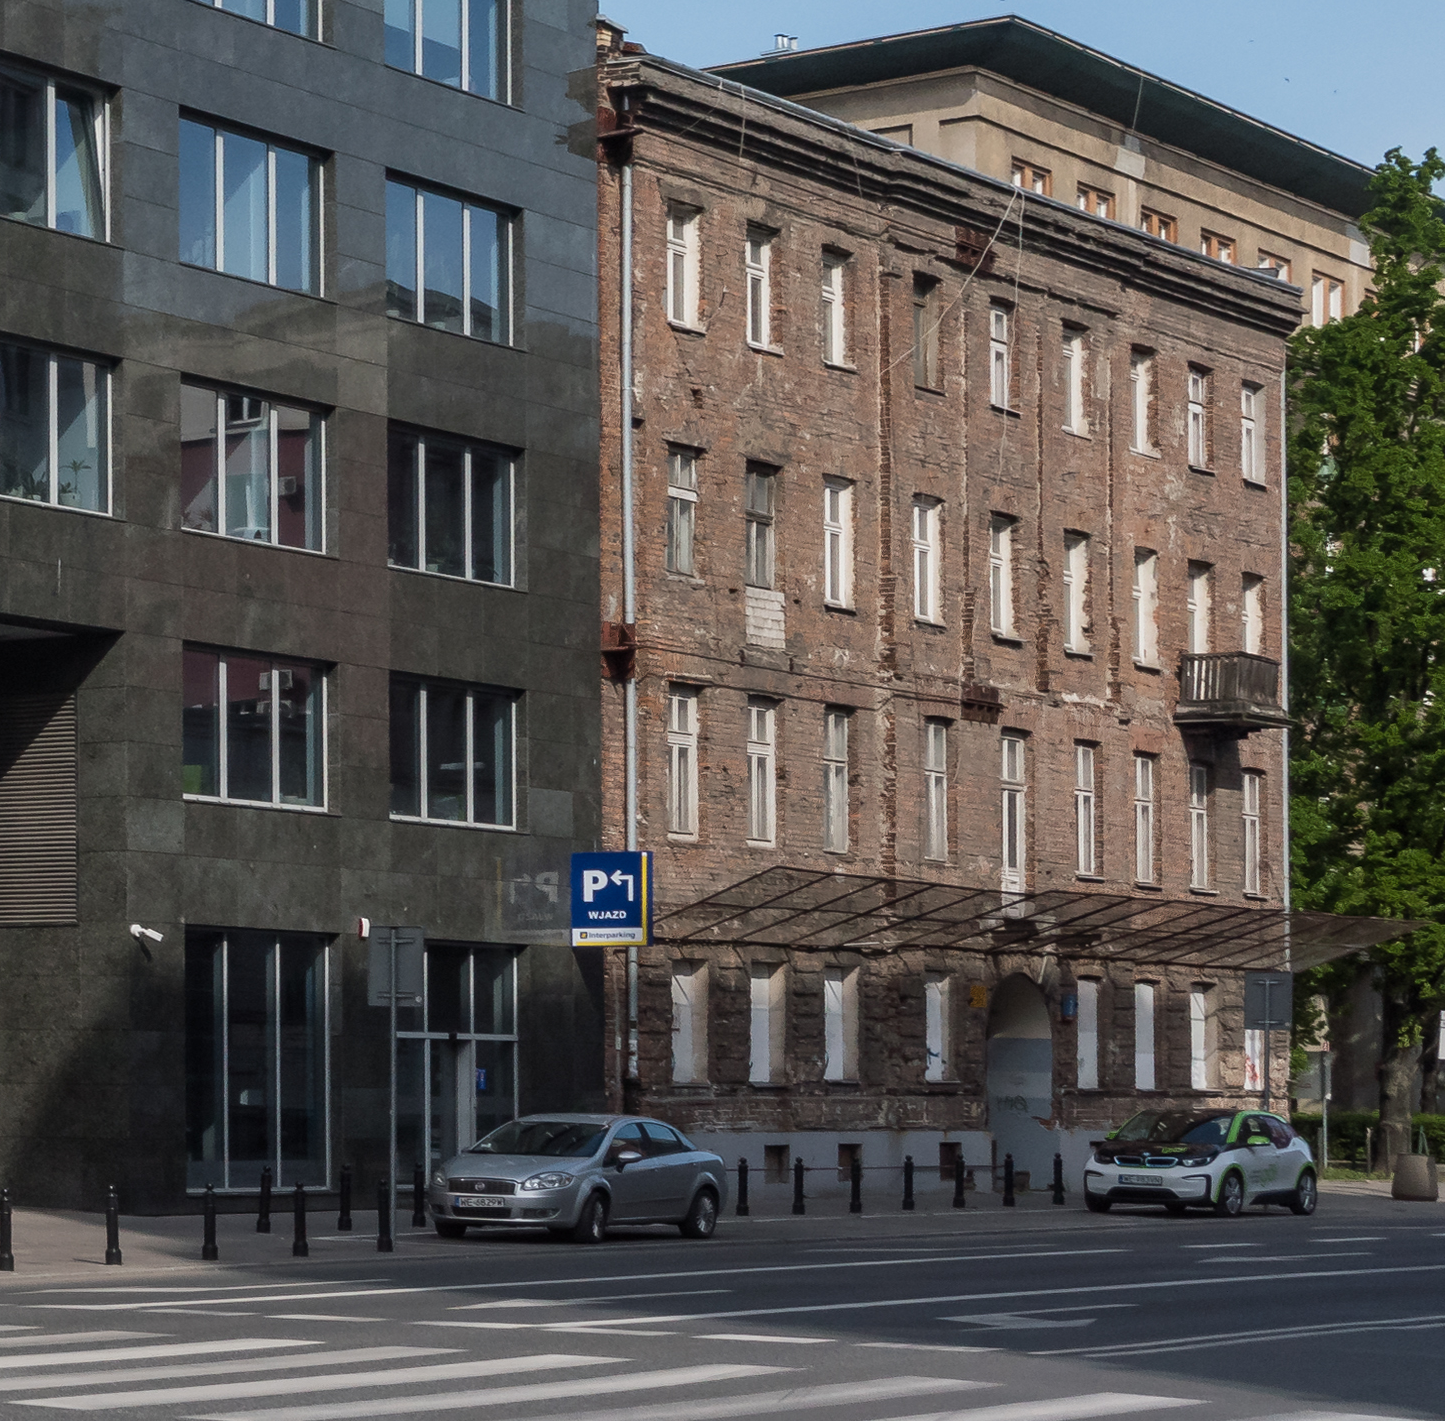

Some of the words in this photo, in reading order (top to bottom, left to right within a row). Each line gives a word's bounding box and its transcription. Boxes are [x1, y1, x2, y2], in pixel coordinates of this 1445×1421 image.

[582, 869, 609, 903] P
[588, 910, 627, 920] WJAZD
[588, 931, 636, 940] Interparking
[460, 1198, 473, 1207] WE
